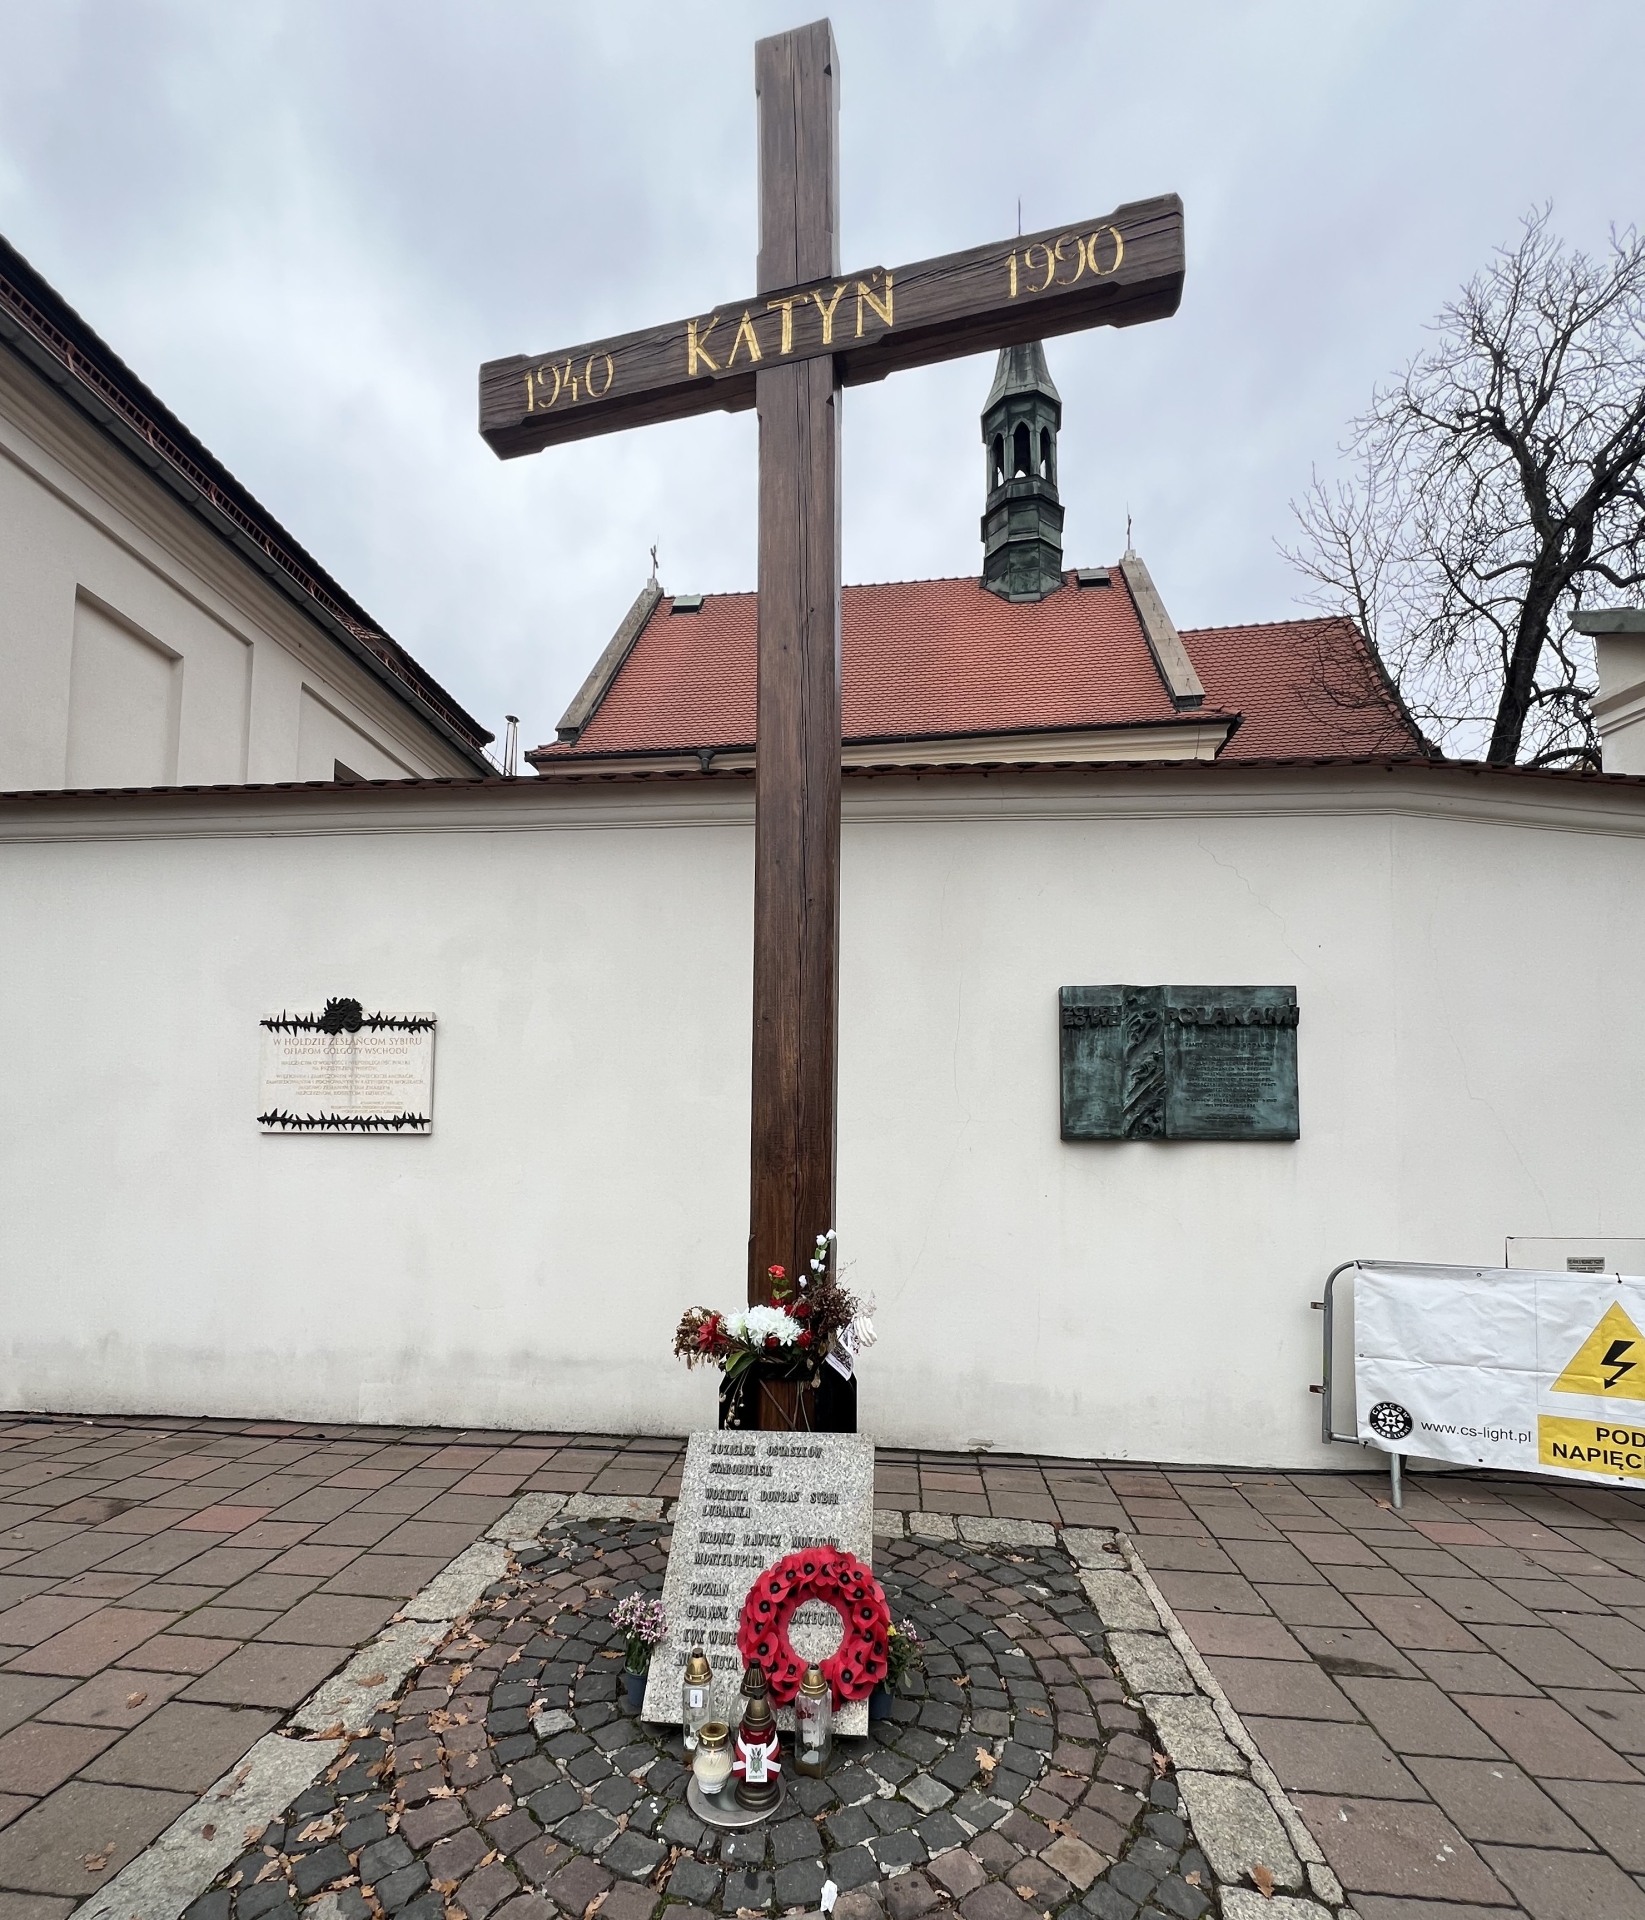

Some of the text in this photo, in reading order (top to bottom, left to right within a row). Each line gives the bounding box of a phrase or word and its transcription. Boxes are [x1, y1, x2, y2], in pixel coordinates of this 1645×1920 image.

[525, 224, 1124, 412] 1940 KATYŃ 1990
[272, 1037, 282, 1046] W
[389, 1037, 422, 1046] SYBIRU
[284, 1047, 408, 1055] OFIAROM GOLGOTY WSCHODU
[1420, 1421, 1532, 1444] www.cs-light.pl
[708, 1630, 738, 1646] WUJE
